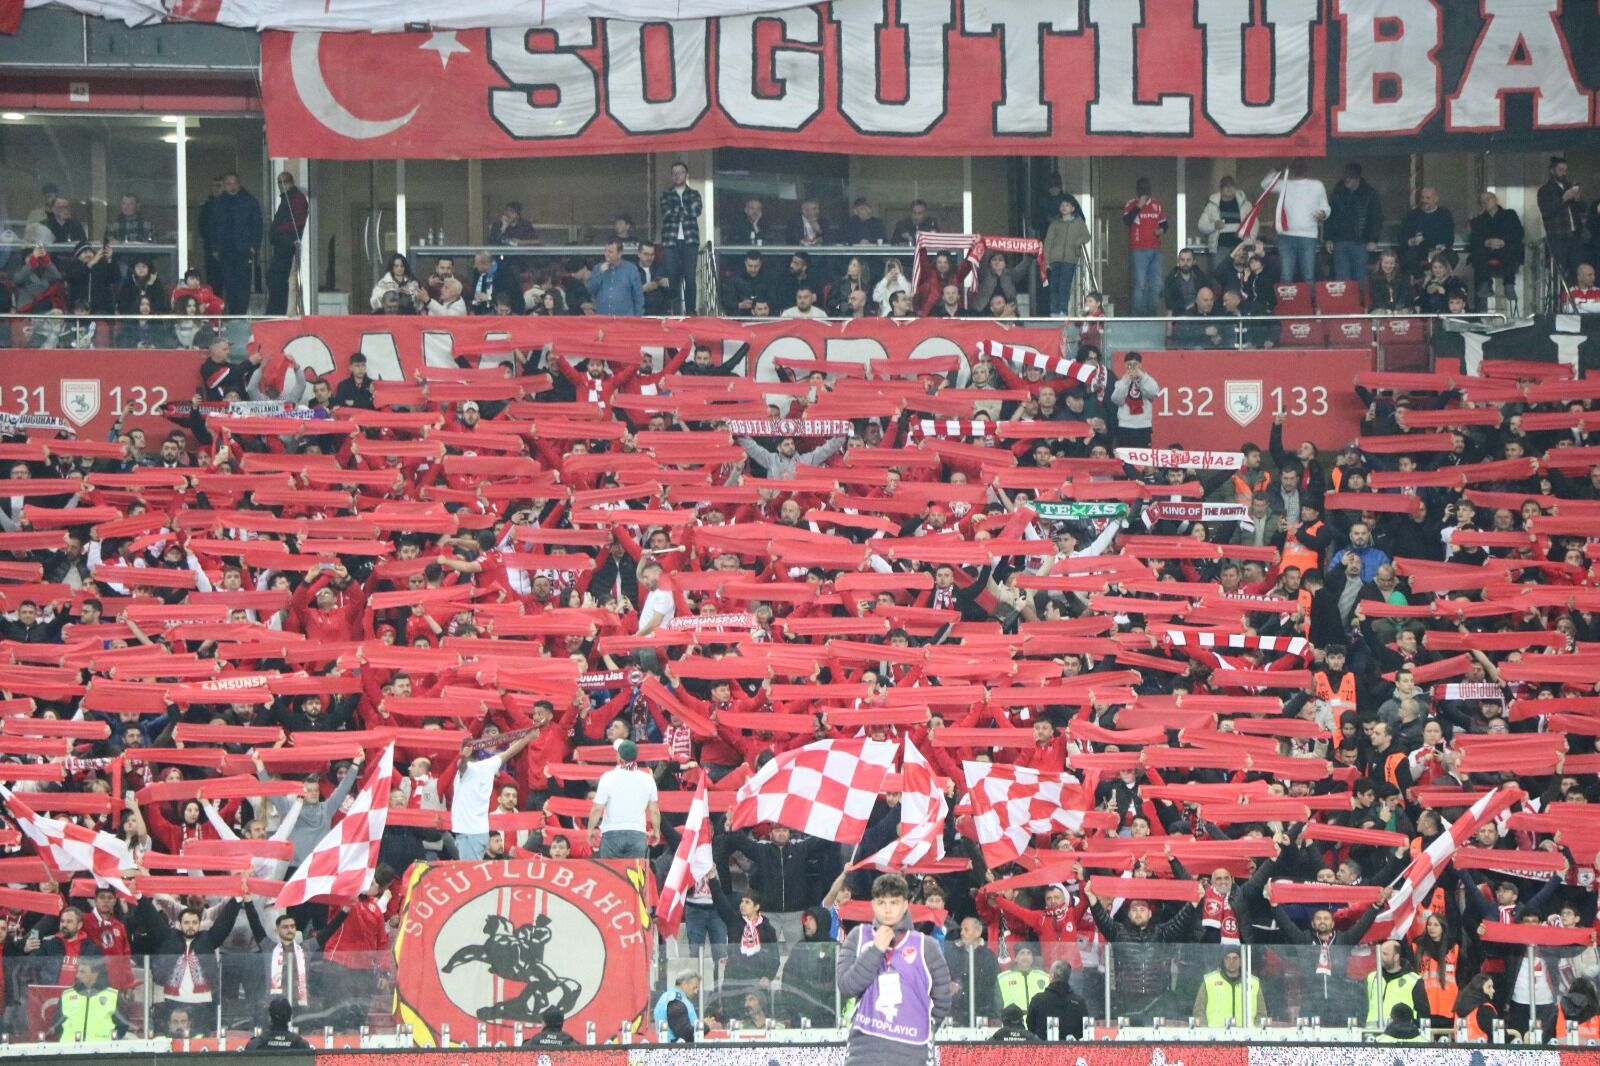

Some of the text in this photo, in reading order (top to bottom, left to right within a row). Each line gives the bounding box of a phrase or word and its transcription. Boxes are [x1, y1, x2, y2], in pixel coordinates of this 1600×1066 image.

[0, 386, 45, 416] 31
[109, 386, 168, 416] 132
[1157, 386, 1214, 416] 132
[1270, 386, 1329, 416] 133
[1040, 502, 1117, 515] TEXAS
[1161, 505, 1247, 517] KING OF THE NORTH
[1225, 919, 1237, 931] 55
[856, 1014, 918, 1037] TOP TOPLAYICI
